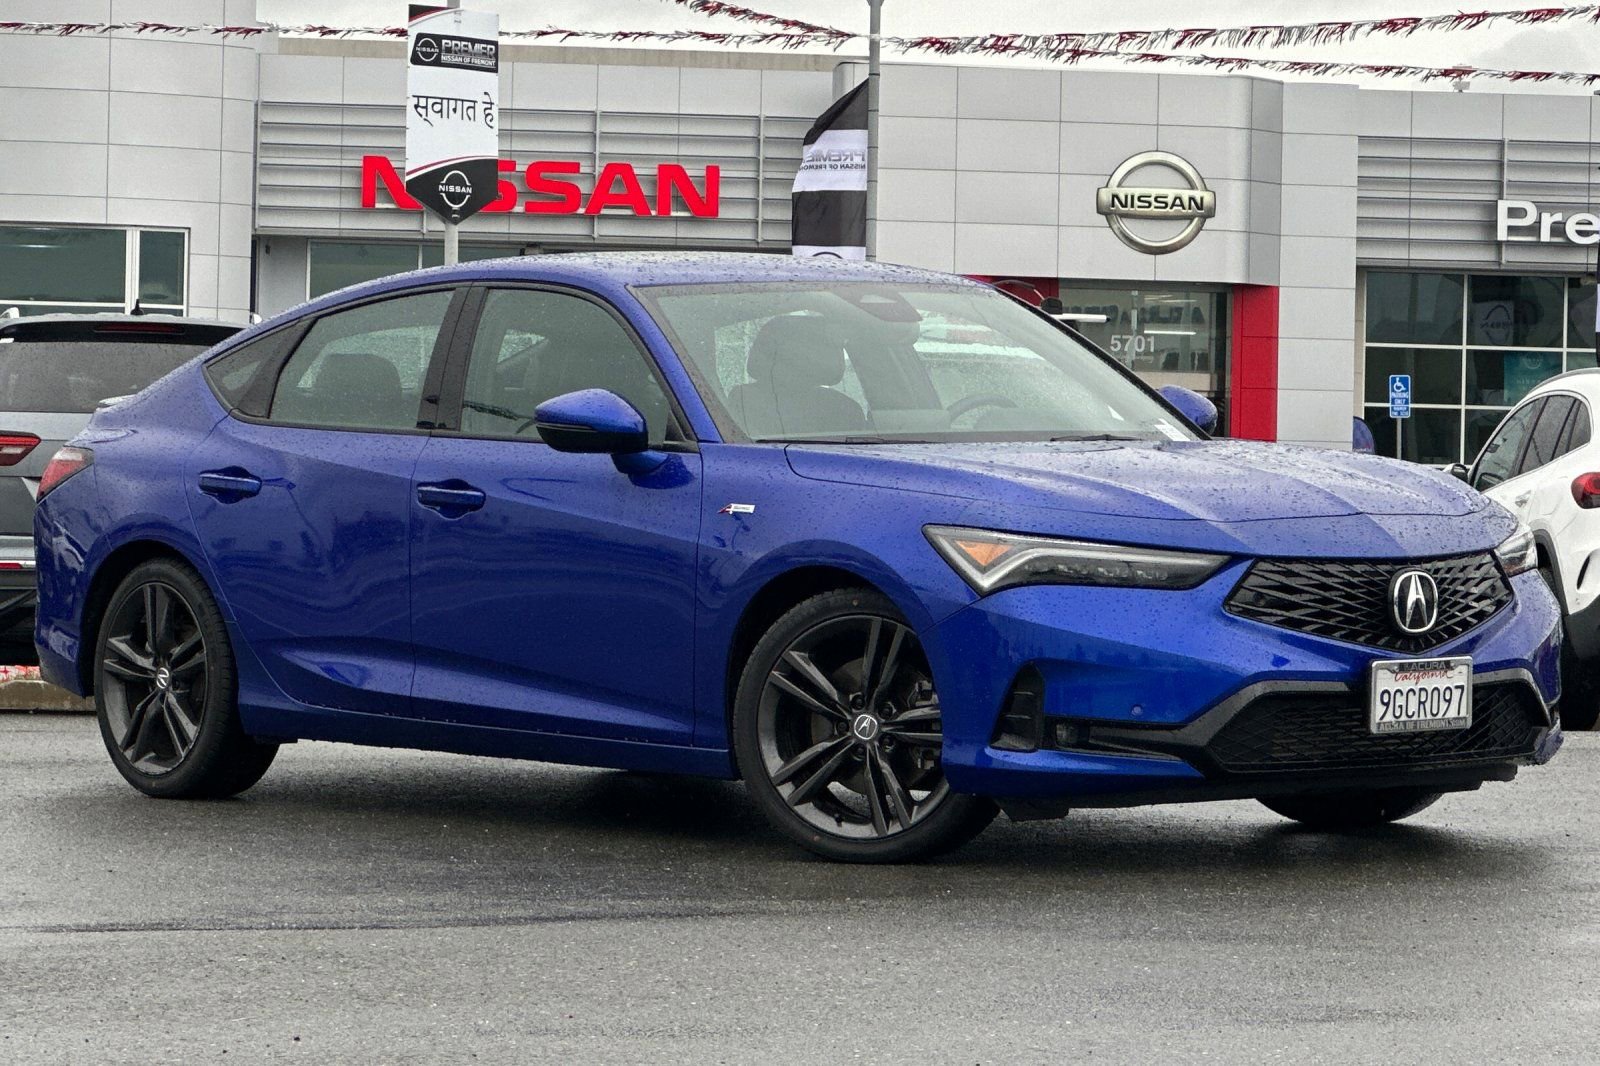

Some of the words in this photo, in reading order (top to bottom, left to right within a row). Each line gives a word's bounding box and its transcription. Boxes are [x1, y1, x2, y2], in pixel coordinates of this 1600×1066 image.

[441, 39, 495, 57] PREMIER
[441, 55, 463, 63] NISSAN
[471, 58, 496, 66] FREMONT
[362, 155, 720, 218] NSAN
[438, 184, 473, 195] NISSAN
[1110, 193, 1205, 211] NISSAN
[1110, 334, 1155, 353] 5701
[1394, 669, 1454, 686] California
[1379, 685, 1465, 720] 9GCR097
